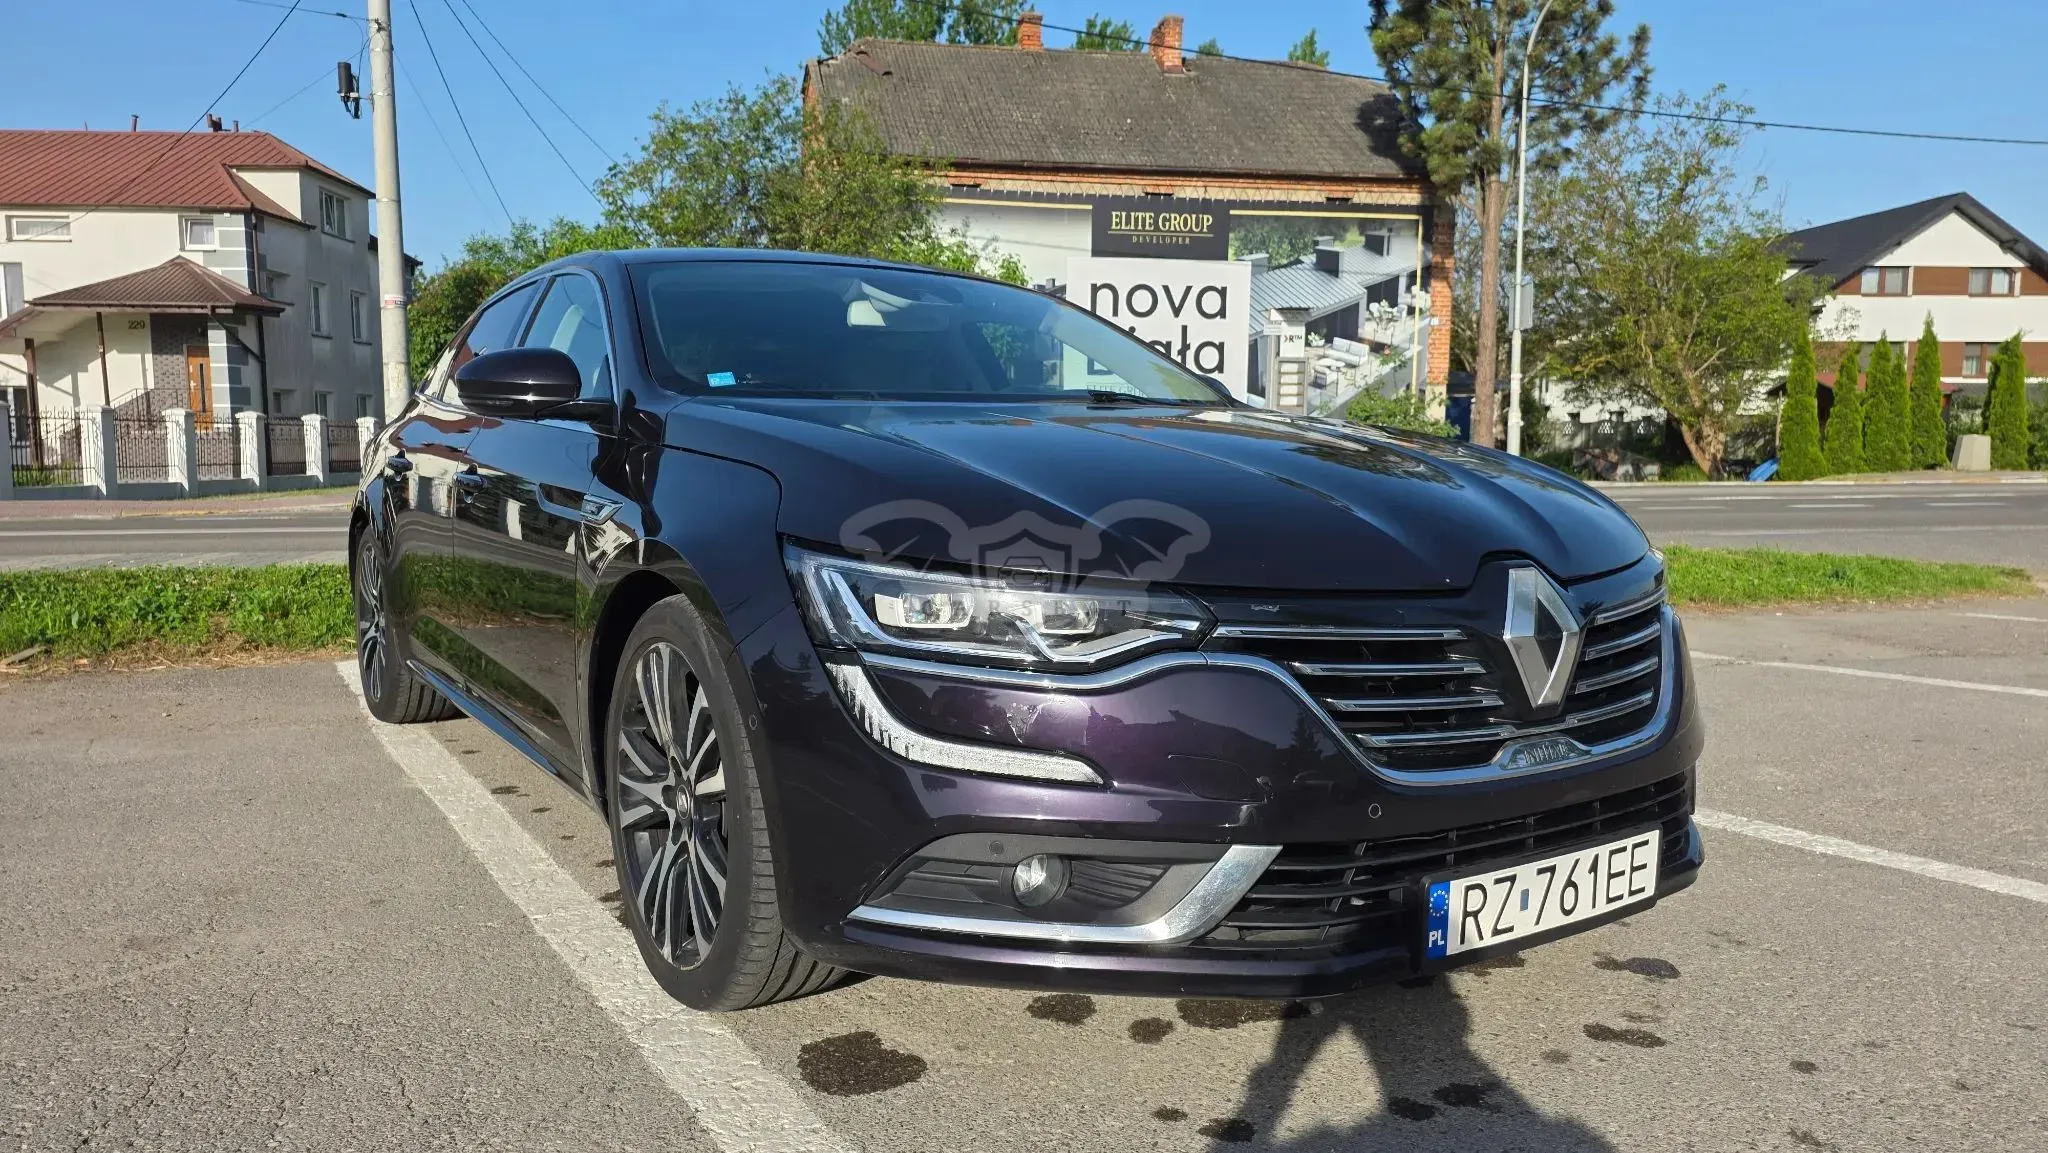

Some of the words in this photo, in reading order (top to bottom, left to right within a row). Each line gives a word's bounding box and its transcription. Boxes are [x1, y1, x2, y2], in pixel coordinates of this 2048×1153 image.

[1110, 210, 1155, 230] ELITE
[1158, 212, 1213, 232] GROUP
[1132, 235, 1191, 245] DEVELOPER
[1089, 282, 1228, 320] nova
[1459, 874, 1518, 946] RZ
[1534, 838, 1650, 926] 761EE
[1428, 929, 1445, 948] PL
